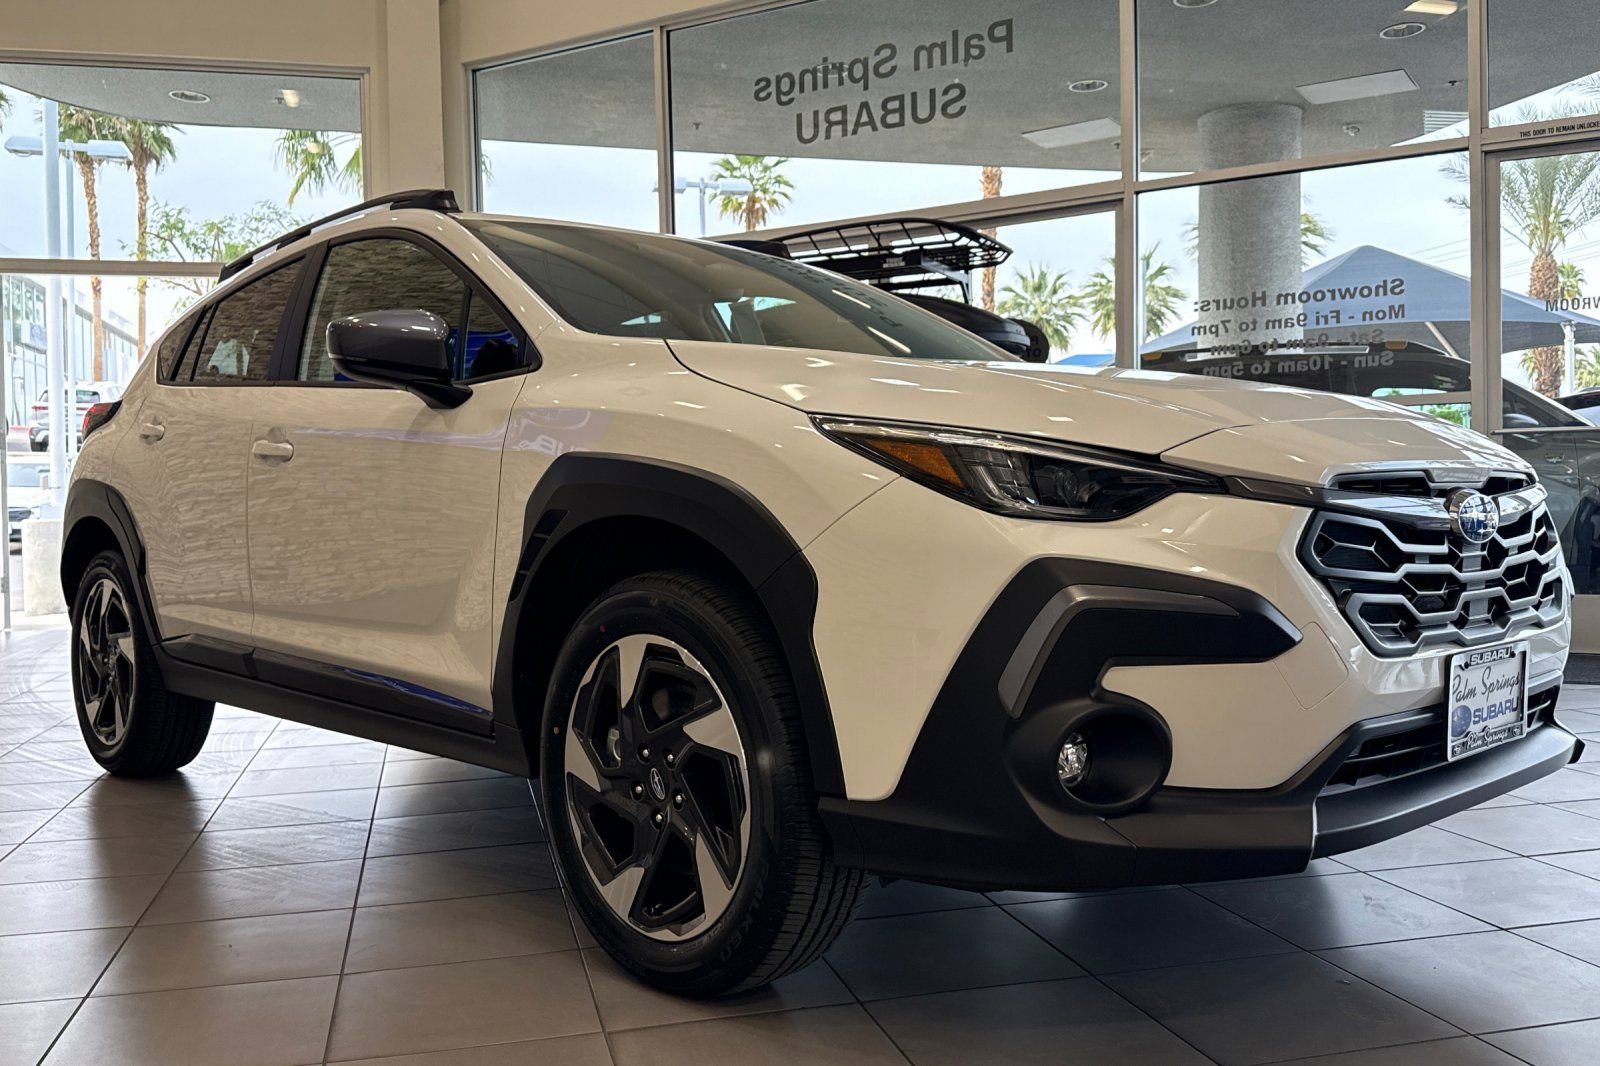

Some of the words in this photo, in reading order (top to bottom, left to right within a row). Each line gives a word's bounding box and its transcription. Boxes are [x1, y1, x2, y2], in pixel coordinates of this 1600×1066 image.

[1533, 128, 1546, 137] DOOR
[1555, 125, 1576, 133] REMAIN
[1471, 648, 1511, 665] SUBARU
[1453, 674, 1478, 703] Palm
[1481, 666, 1520, 703] Springs
[1473, 697, 1519, 725] SUBARU
